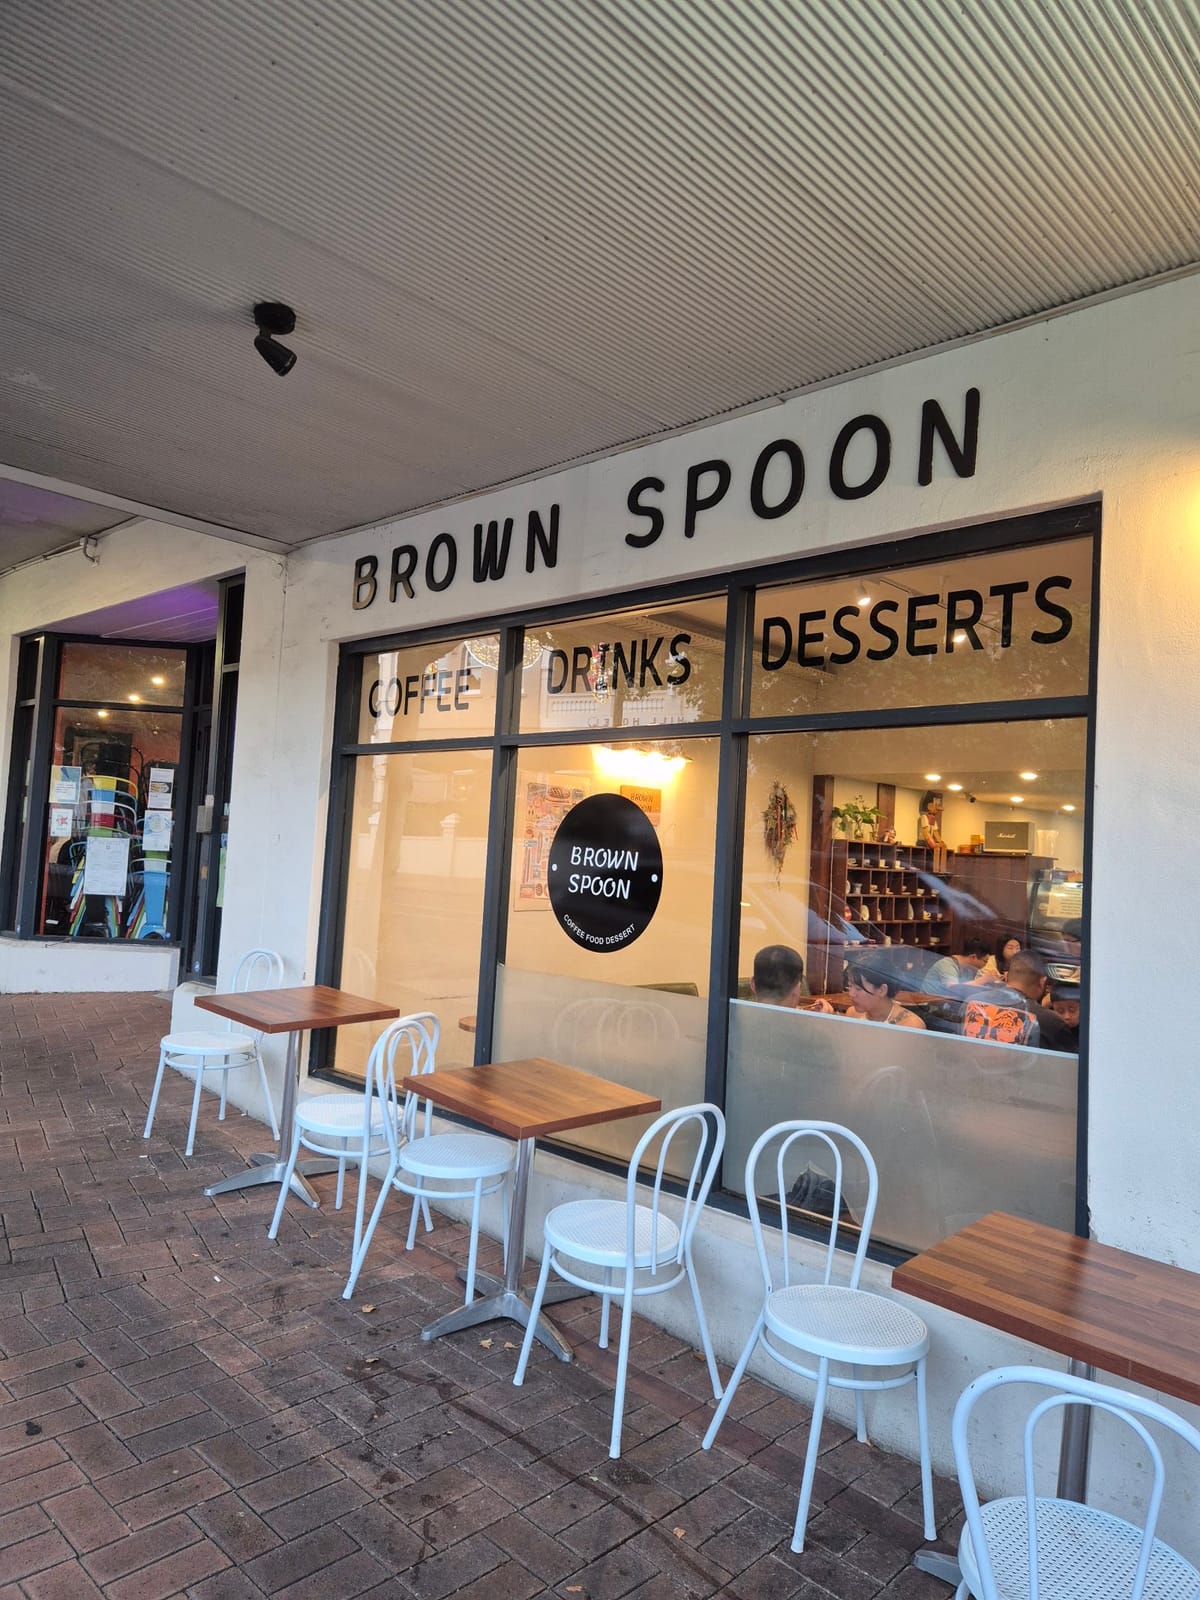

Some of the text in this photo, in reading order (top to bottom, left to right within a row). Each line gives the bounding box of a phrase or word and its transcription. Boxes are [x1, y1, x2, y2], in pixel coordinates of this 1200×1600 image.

[352, 387, 980, 610] BROWN SPOON
[761, 575, 1073, 671] DESSERTS
[547, 633, 692, 694] DRINKS
[368, 669, 470, 718] COFFEE
[571, 846, 639, 871] BROWN
[568, 874, 630, 900] SPOON
[563, 914, 635, 944] COFFEE FOOD DESSERT
